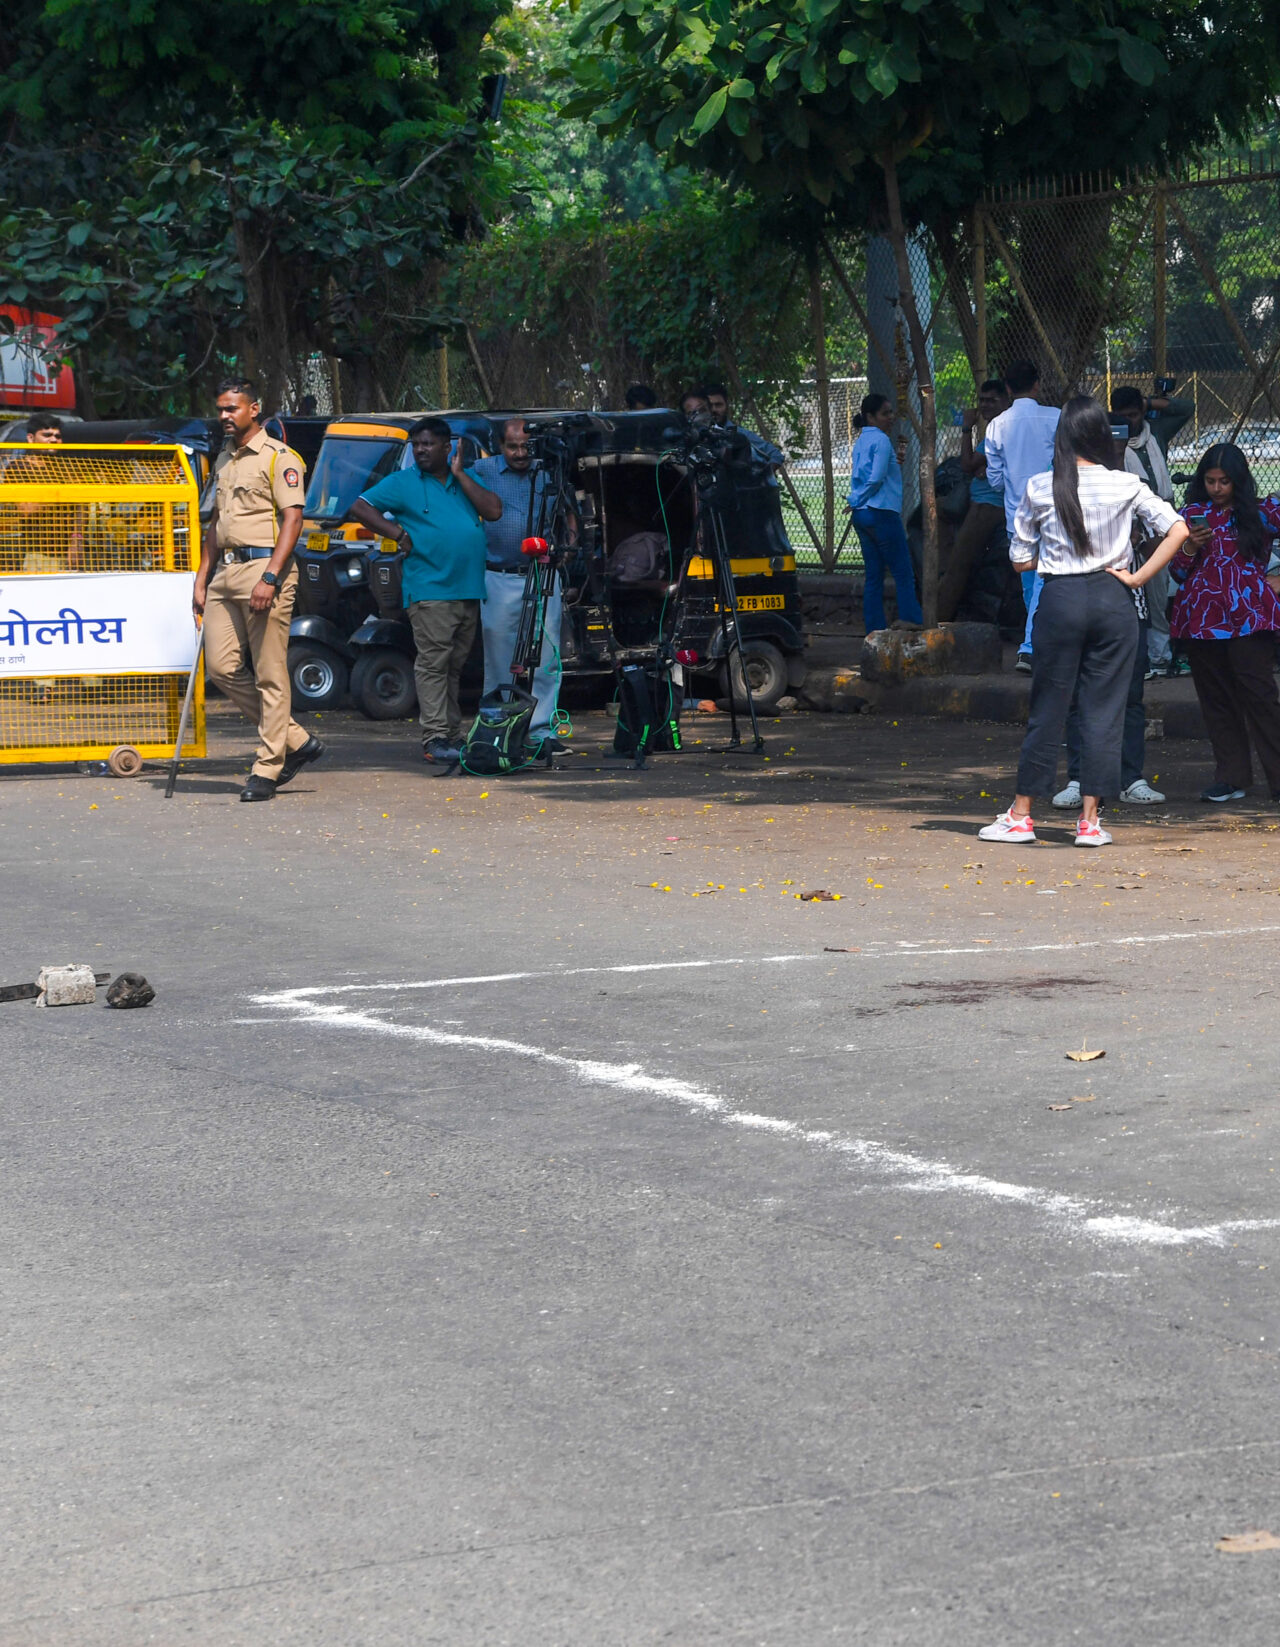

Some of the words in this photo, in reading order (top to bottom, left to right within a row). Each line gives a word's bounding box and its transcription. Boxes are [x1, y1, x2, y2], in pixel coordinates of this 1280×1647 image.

[747, 598, 758, 609] FB
[760, 597, 781, 609] 1083
[0, 608, 127, 646] पोलीस
[8, 653, 26, 664] ठाणे
